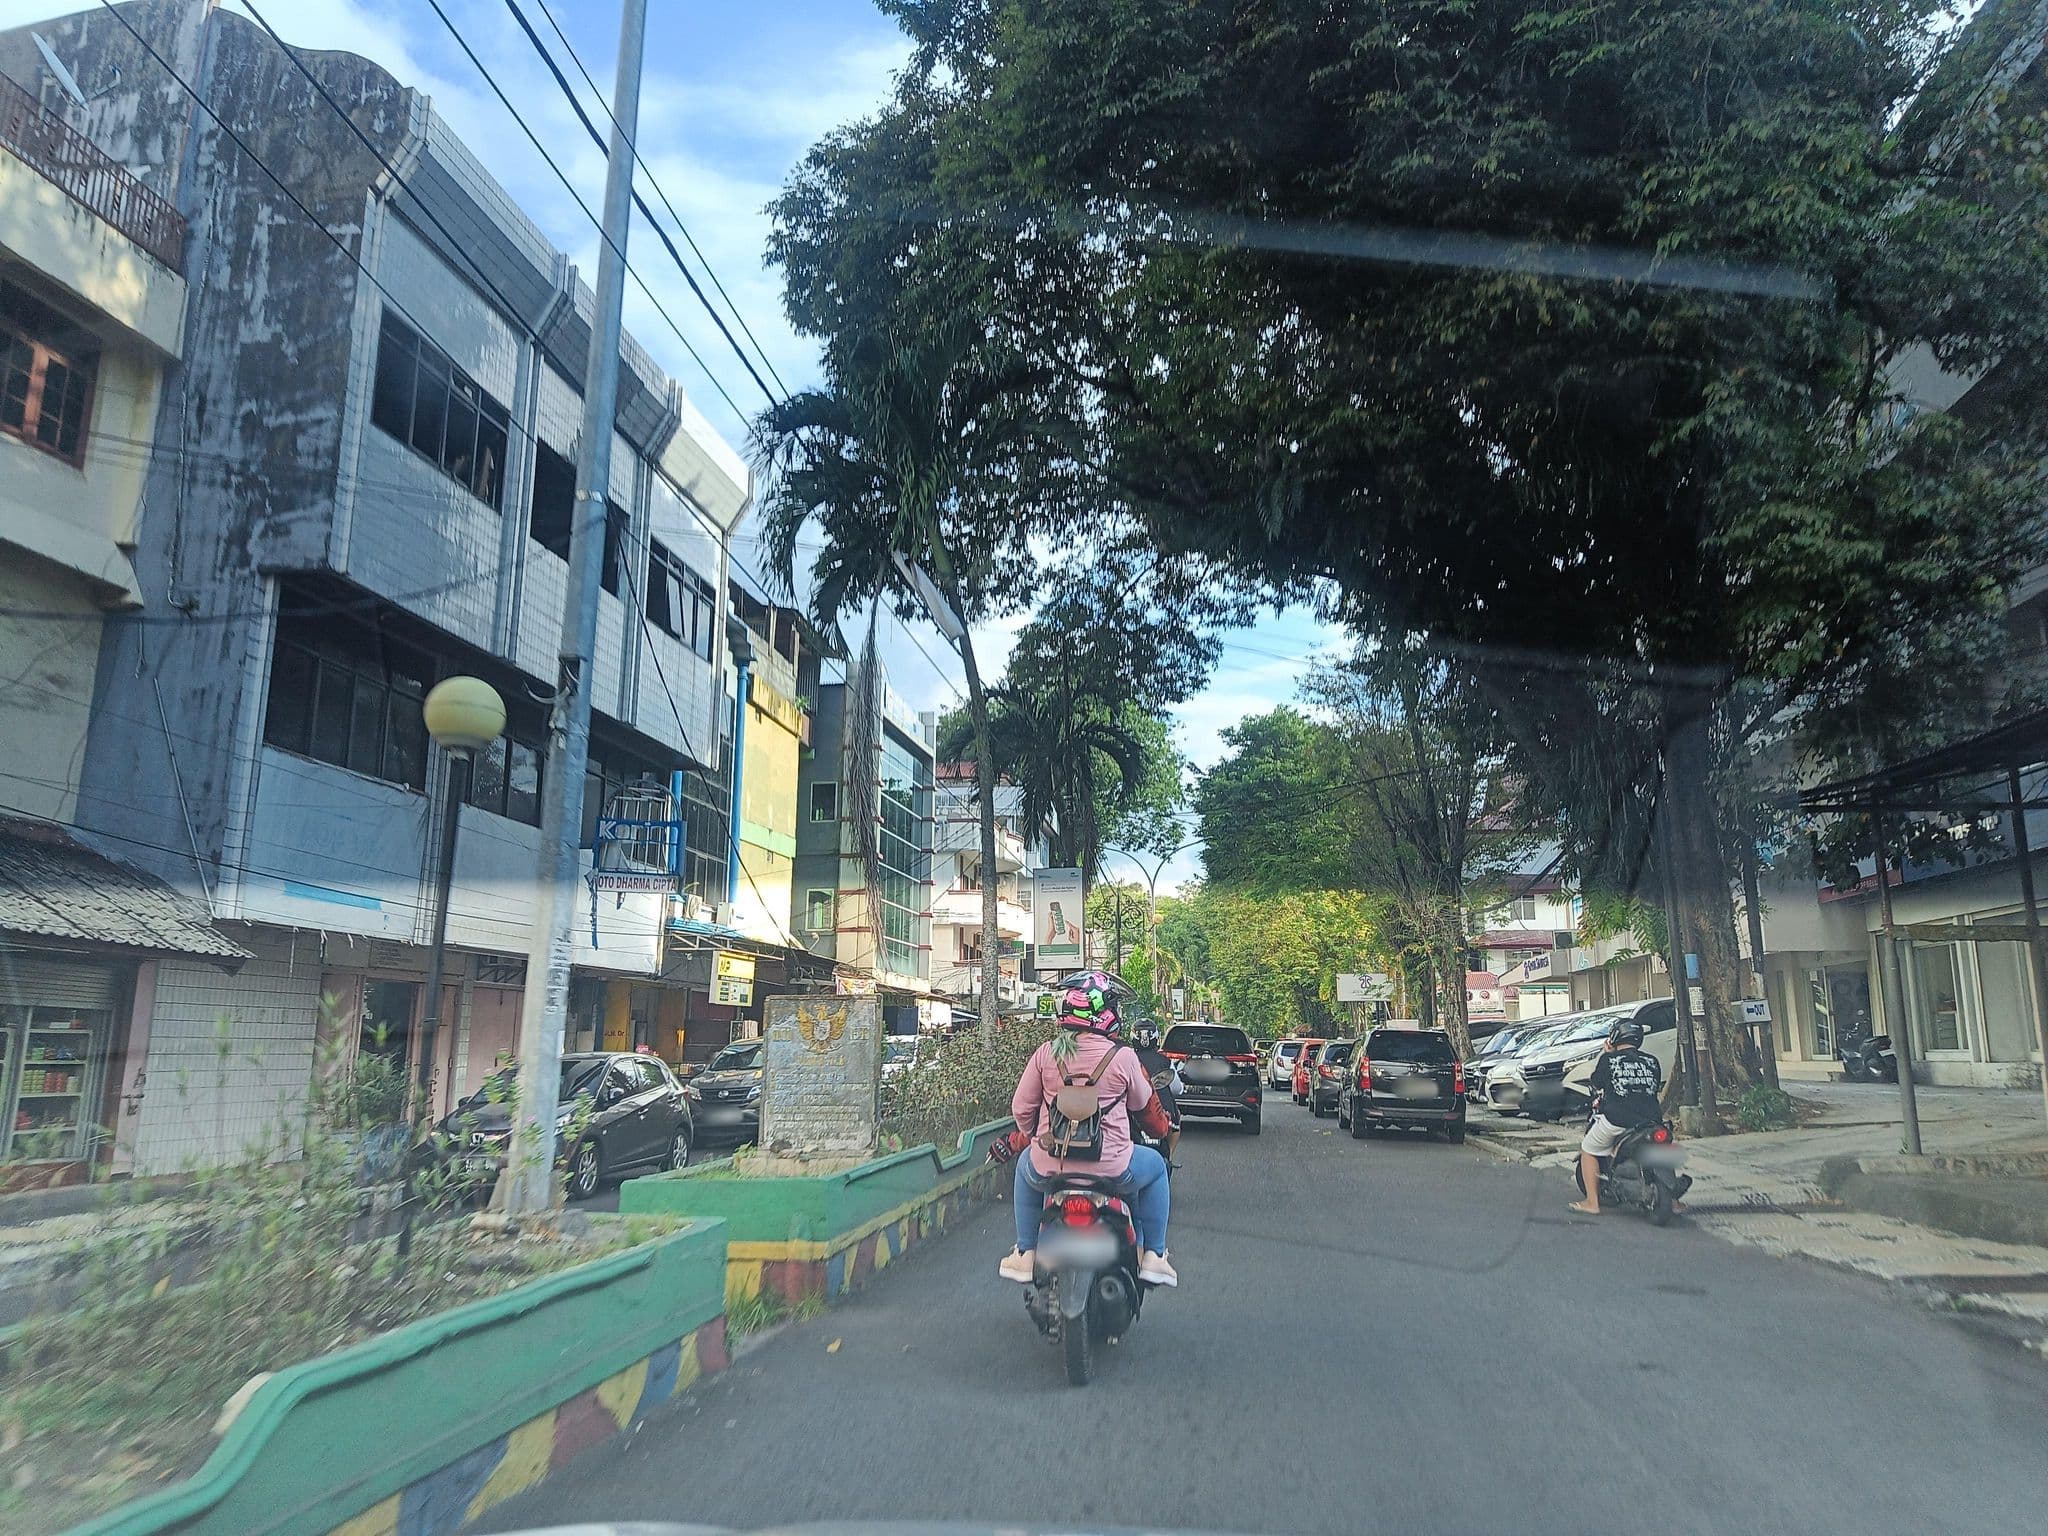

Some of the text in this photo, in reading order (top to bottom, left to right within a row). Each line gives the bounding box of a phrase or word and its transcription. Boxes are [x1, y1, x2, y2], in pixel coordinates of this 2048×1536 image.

[598, 876, 677, 892] OTO DHARMA CIPTA
